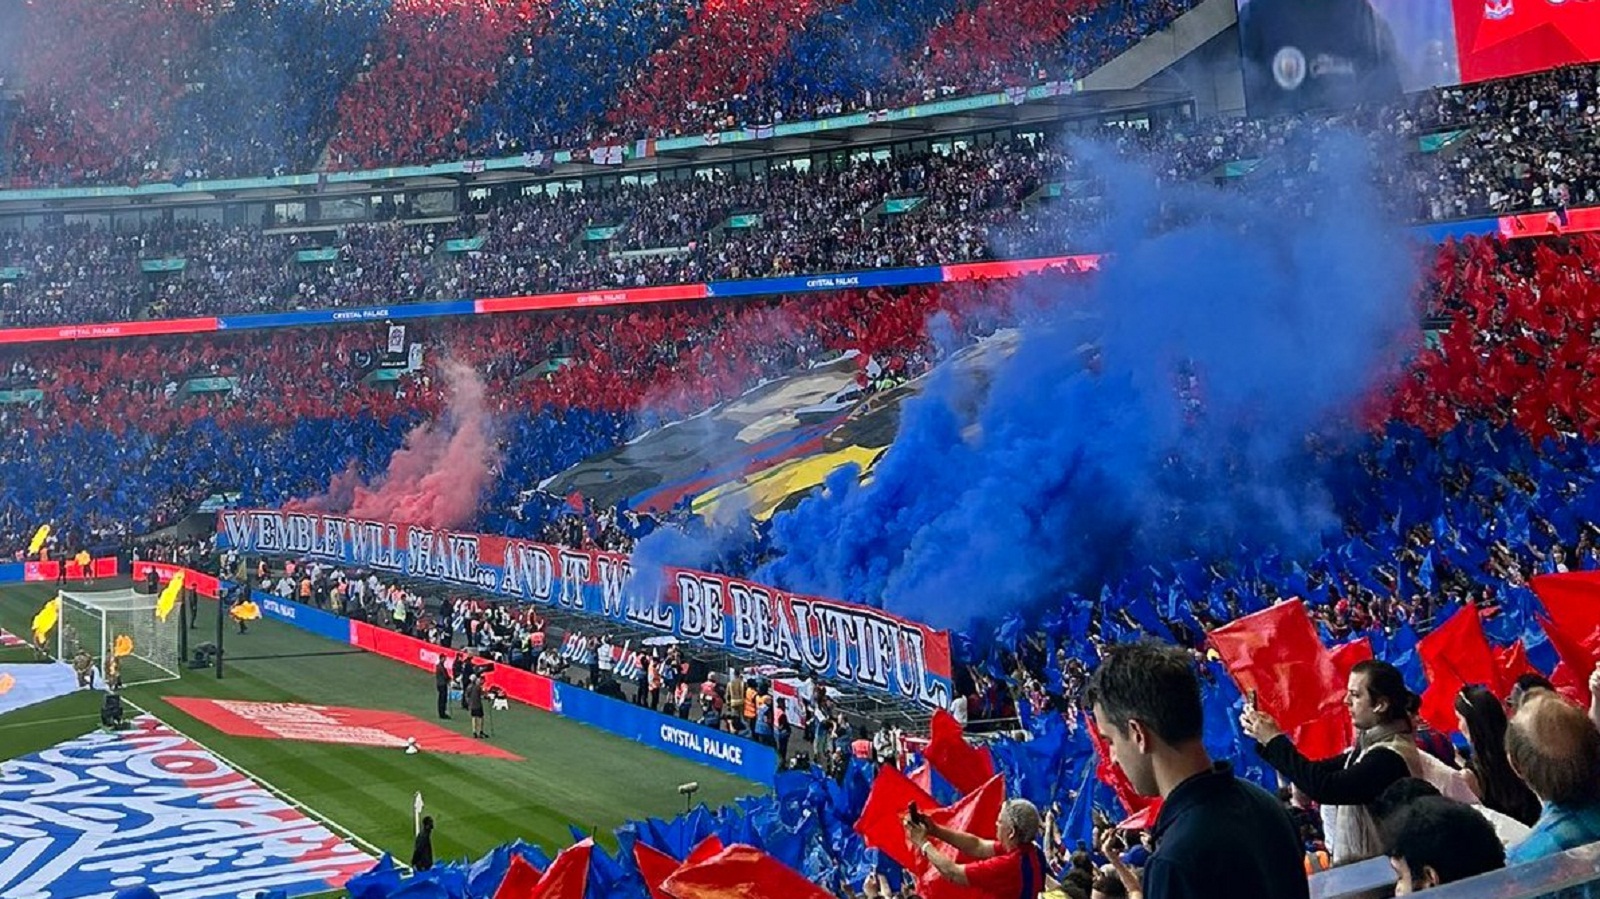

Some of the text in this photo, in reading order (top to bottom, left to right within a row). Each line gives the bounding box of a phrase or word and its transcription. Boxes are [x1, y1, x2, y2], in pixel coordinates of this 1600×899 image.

[806, 276, 859, 287] CRYSTAL PALACE
[332, 309, 389, 319] CRYSTAL PALACE
[223, 511, 346, 560] WEMBLEY
[349, 519, 402, 571] WILL
[501, 541, 554, 602] AND
[559, 551, 590, 609] IT
[677, 574, 725, 644] BE
[660, 724, 743, 766] CRYSTAL PALACE
